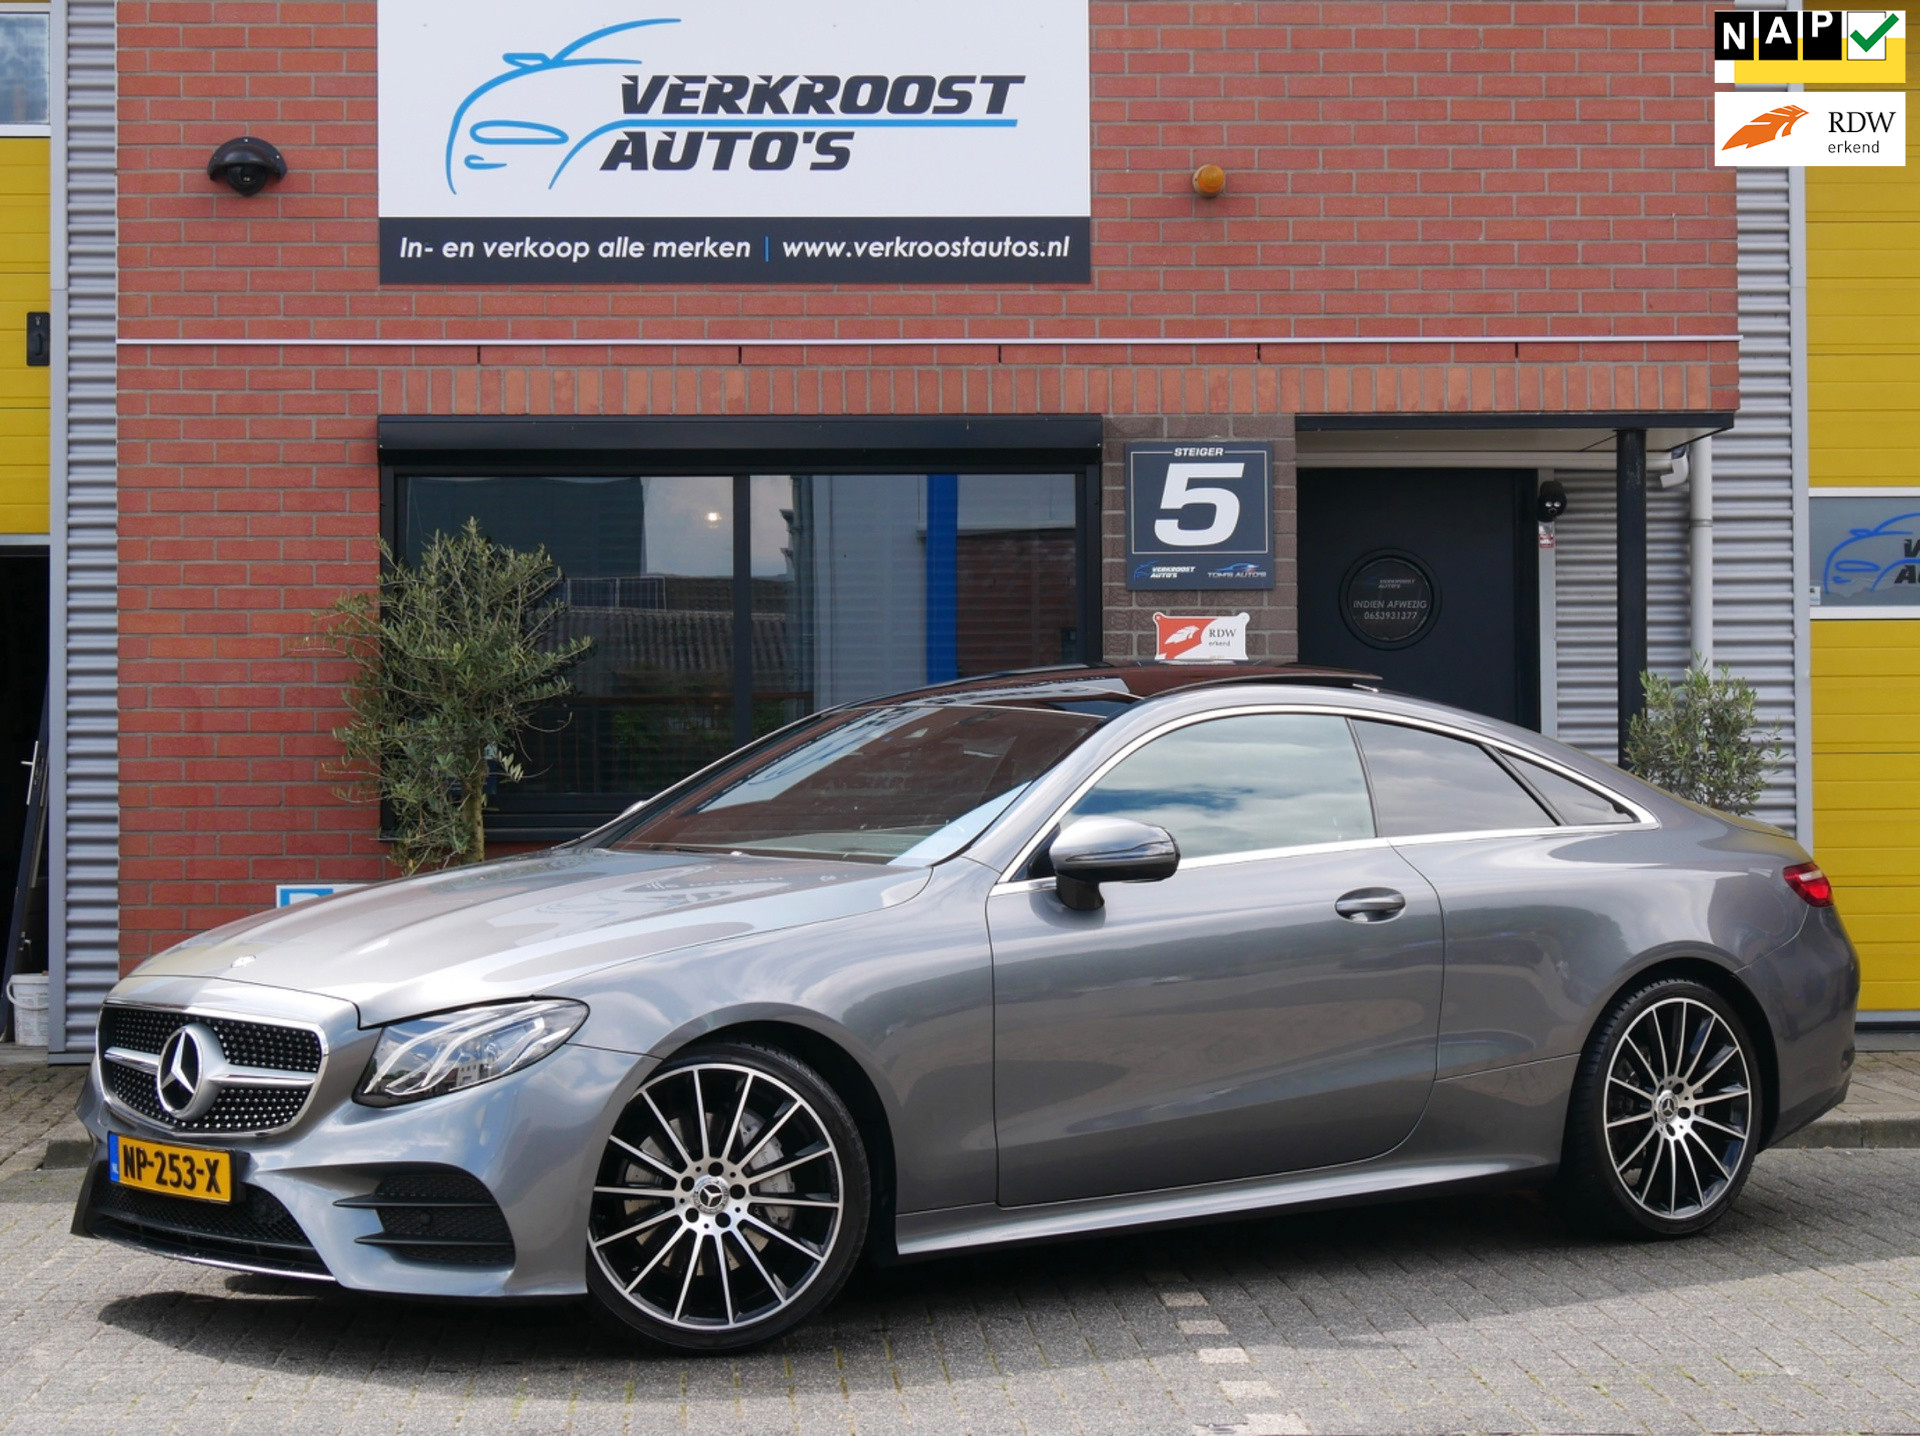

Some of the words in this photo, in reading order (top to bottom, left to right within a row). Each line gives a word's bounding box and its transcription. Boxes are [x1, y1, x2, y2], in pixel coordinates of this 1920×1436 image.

[622, 74, 1026, 115] VERKROOST
[599, 131, 855, 171] AUTO'S
[400, 236, 434, 258] In-
[442, 241, 475, 258] en
[483, 236, 590, 263] verkoop
[597, 236, 645, 258] alle
[652, 236, 751, 258] merken
[782, 236, 1070, 258] www.verkroostautos.nl
[1174, 447, 1224, 457] STEIGER
[1154, 463, 1245, 546] 5
[1353, 600, 1386, 609] INDIEN
[1386, 600, 1428, 609] AFWEZIG
[1209, 629, 1236, 638] RDW
[123, 1144, 221, 1194] NP-253-X
